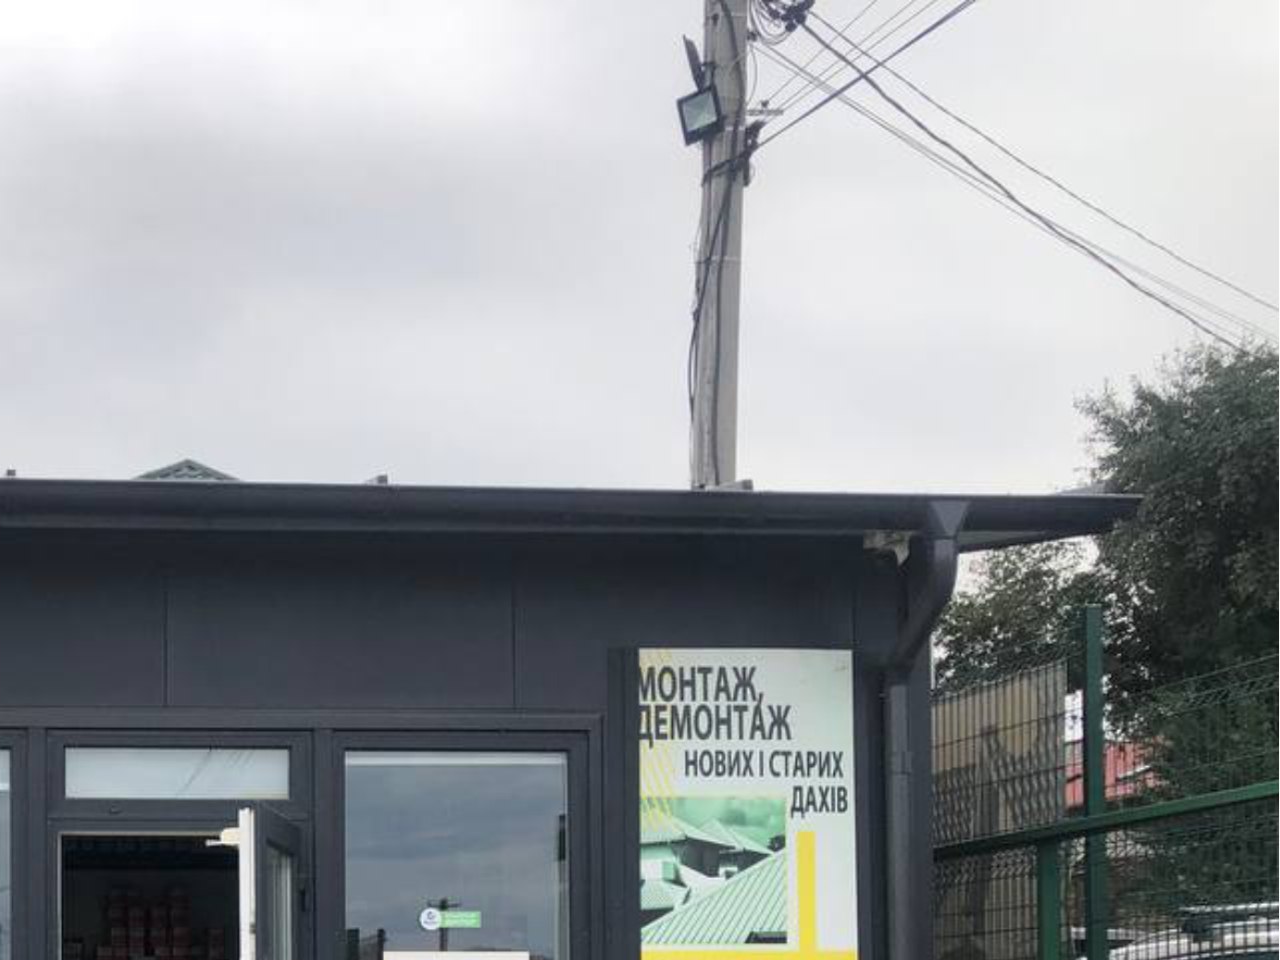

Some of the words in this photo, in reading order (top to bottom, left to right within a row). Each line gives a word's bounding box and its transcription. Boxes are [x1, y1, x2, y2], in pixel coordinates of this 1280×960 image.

[639, 665, 763, 706] МОНТАЖ,
[639, 704, 791, 748] ДЕМОНТАЖ
[684, 750, 753, 777] НОВИХ
[768, 750, 844, 777] СТАРИХ
[791, 785, 848, 818] ДАХІВ
